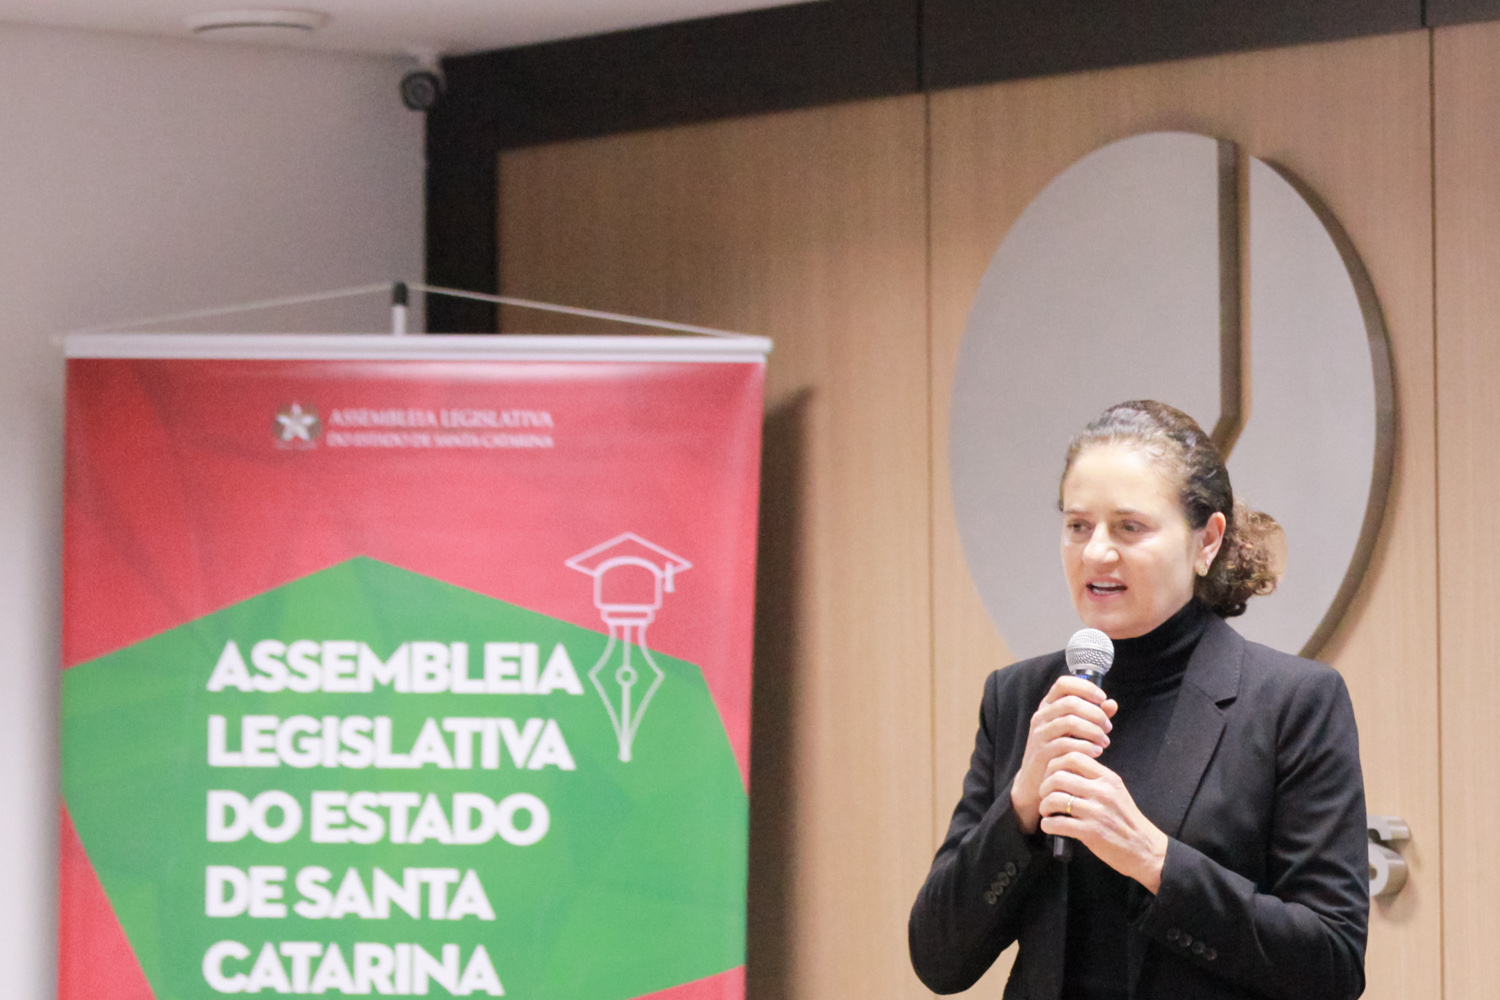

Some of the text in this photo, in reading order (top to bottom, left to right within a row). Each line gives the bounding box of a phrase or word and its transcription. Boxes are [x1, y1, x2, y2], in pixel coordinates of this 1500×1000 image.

[207, 640, 584, 694] ASSEMBLEIA
[208, 715, 576, 771] LEGISLATIVA
[206, 790, 550, 845] DO ESTADO
[205, 866, 496, 920] DE SANTA
[201, 940, 503, 996] CATARINA
